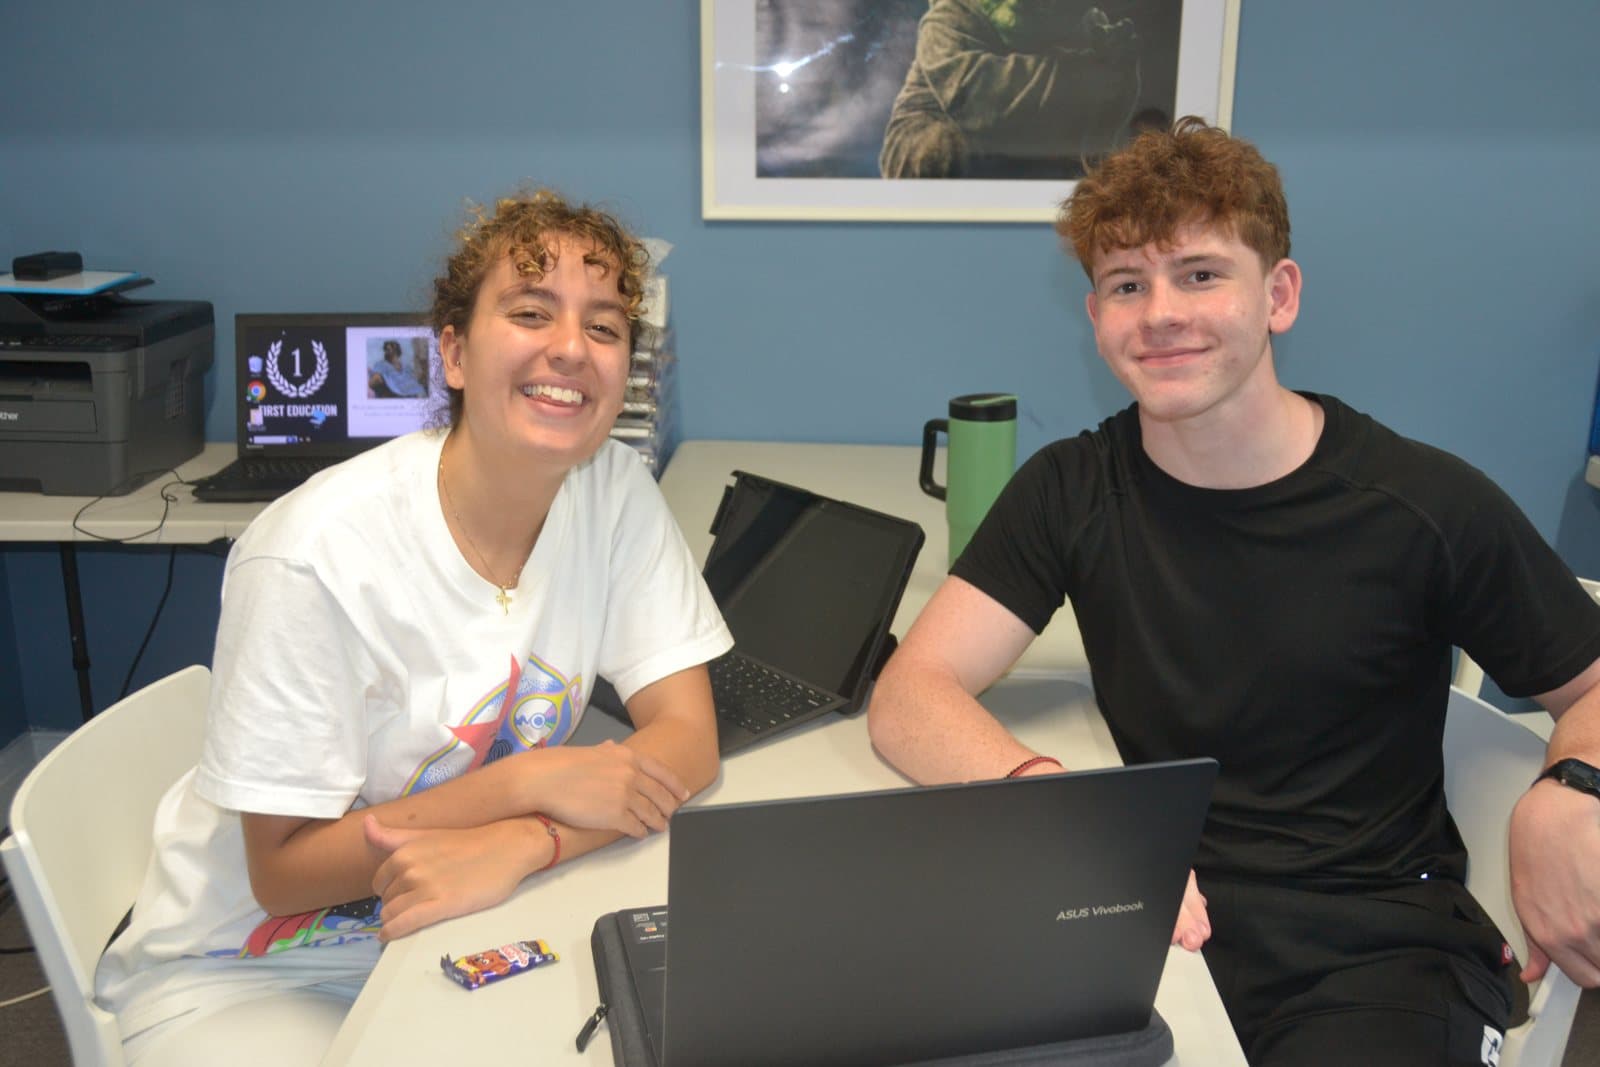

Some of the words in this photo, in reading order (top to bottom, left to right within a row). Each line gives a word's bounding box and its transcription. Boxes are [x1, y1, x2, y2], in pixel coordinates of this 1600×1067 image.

[291, 348, 302, 377] 1
[287, 404, 337, 417] EDUCATION
[1056, 907, 1089, 920] ASUS
[1092, 901, 1144, 916] Vivobook
